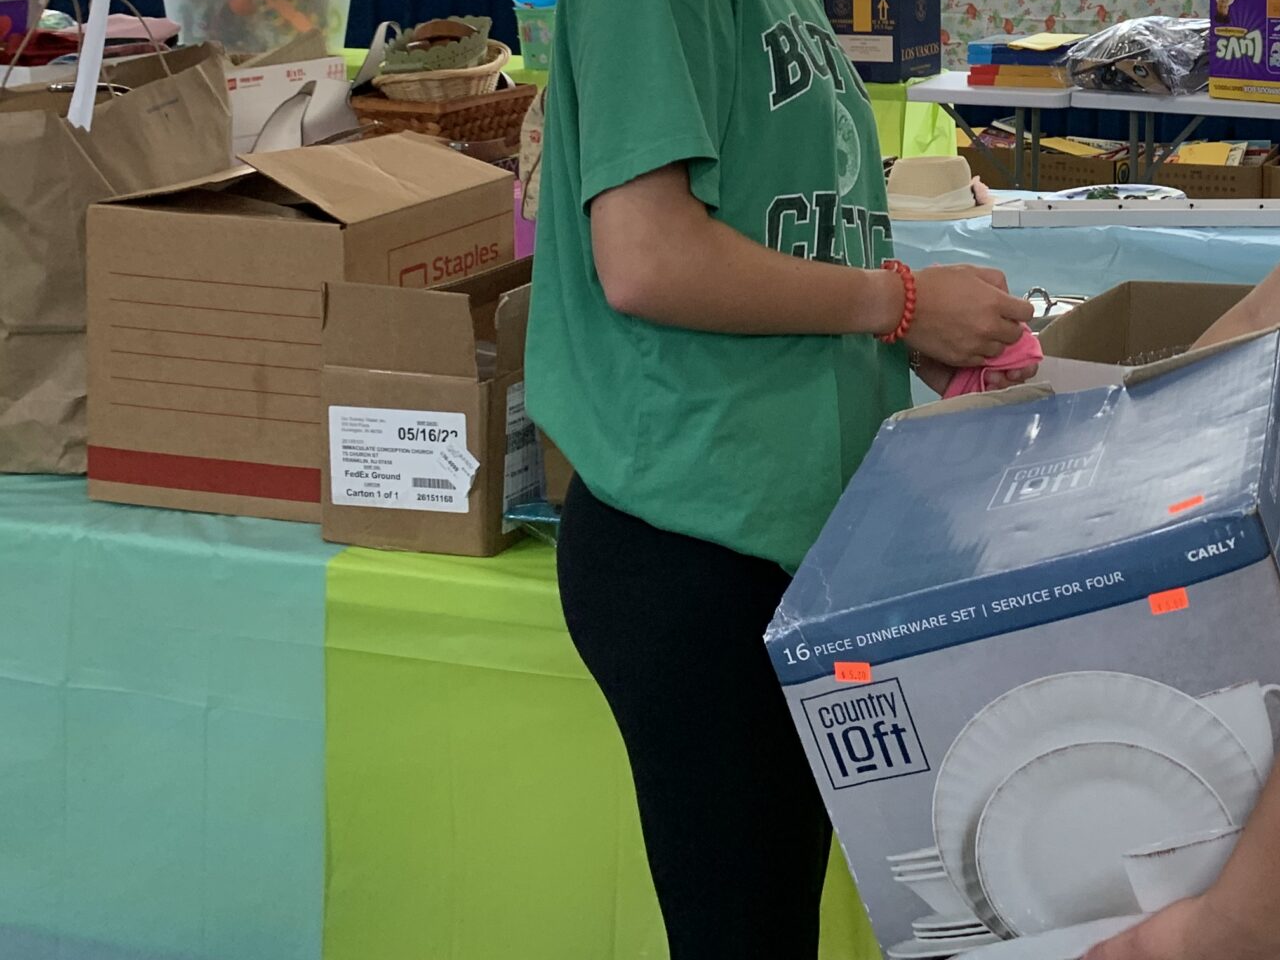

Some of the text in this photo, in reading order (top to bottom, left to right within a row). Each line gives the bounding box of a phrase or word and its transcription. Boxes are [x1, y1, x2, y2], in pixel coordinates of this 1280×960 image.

[1215, 29, 1263, 65] Luvs
[432, 242, 499, 282] Staples
[344, 470, 401, 481] FedEx Ground
[1013, 454, 1095, 481] country
[346, 489, 399, 500] Carton 1 of 1
[1187, 537, 1236, 562] CARLY
[783, 643, 811, 665] 16
[814, 637, 854, 656] PIECE
[856, 613, 948, 647] DINNERWARE
[950, 606, 977, 623] SET
[991, 589, 1052, 613] SERVICE
[1054, 582, 1084, 598] FOR
[1086, 571, 1125, 590] FOUR
[818, 692, 898, 729] country
[826, 720, 912, 778] loft
